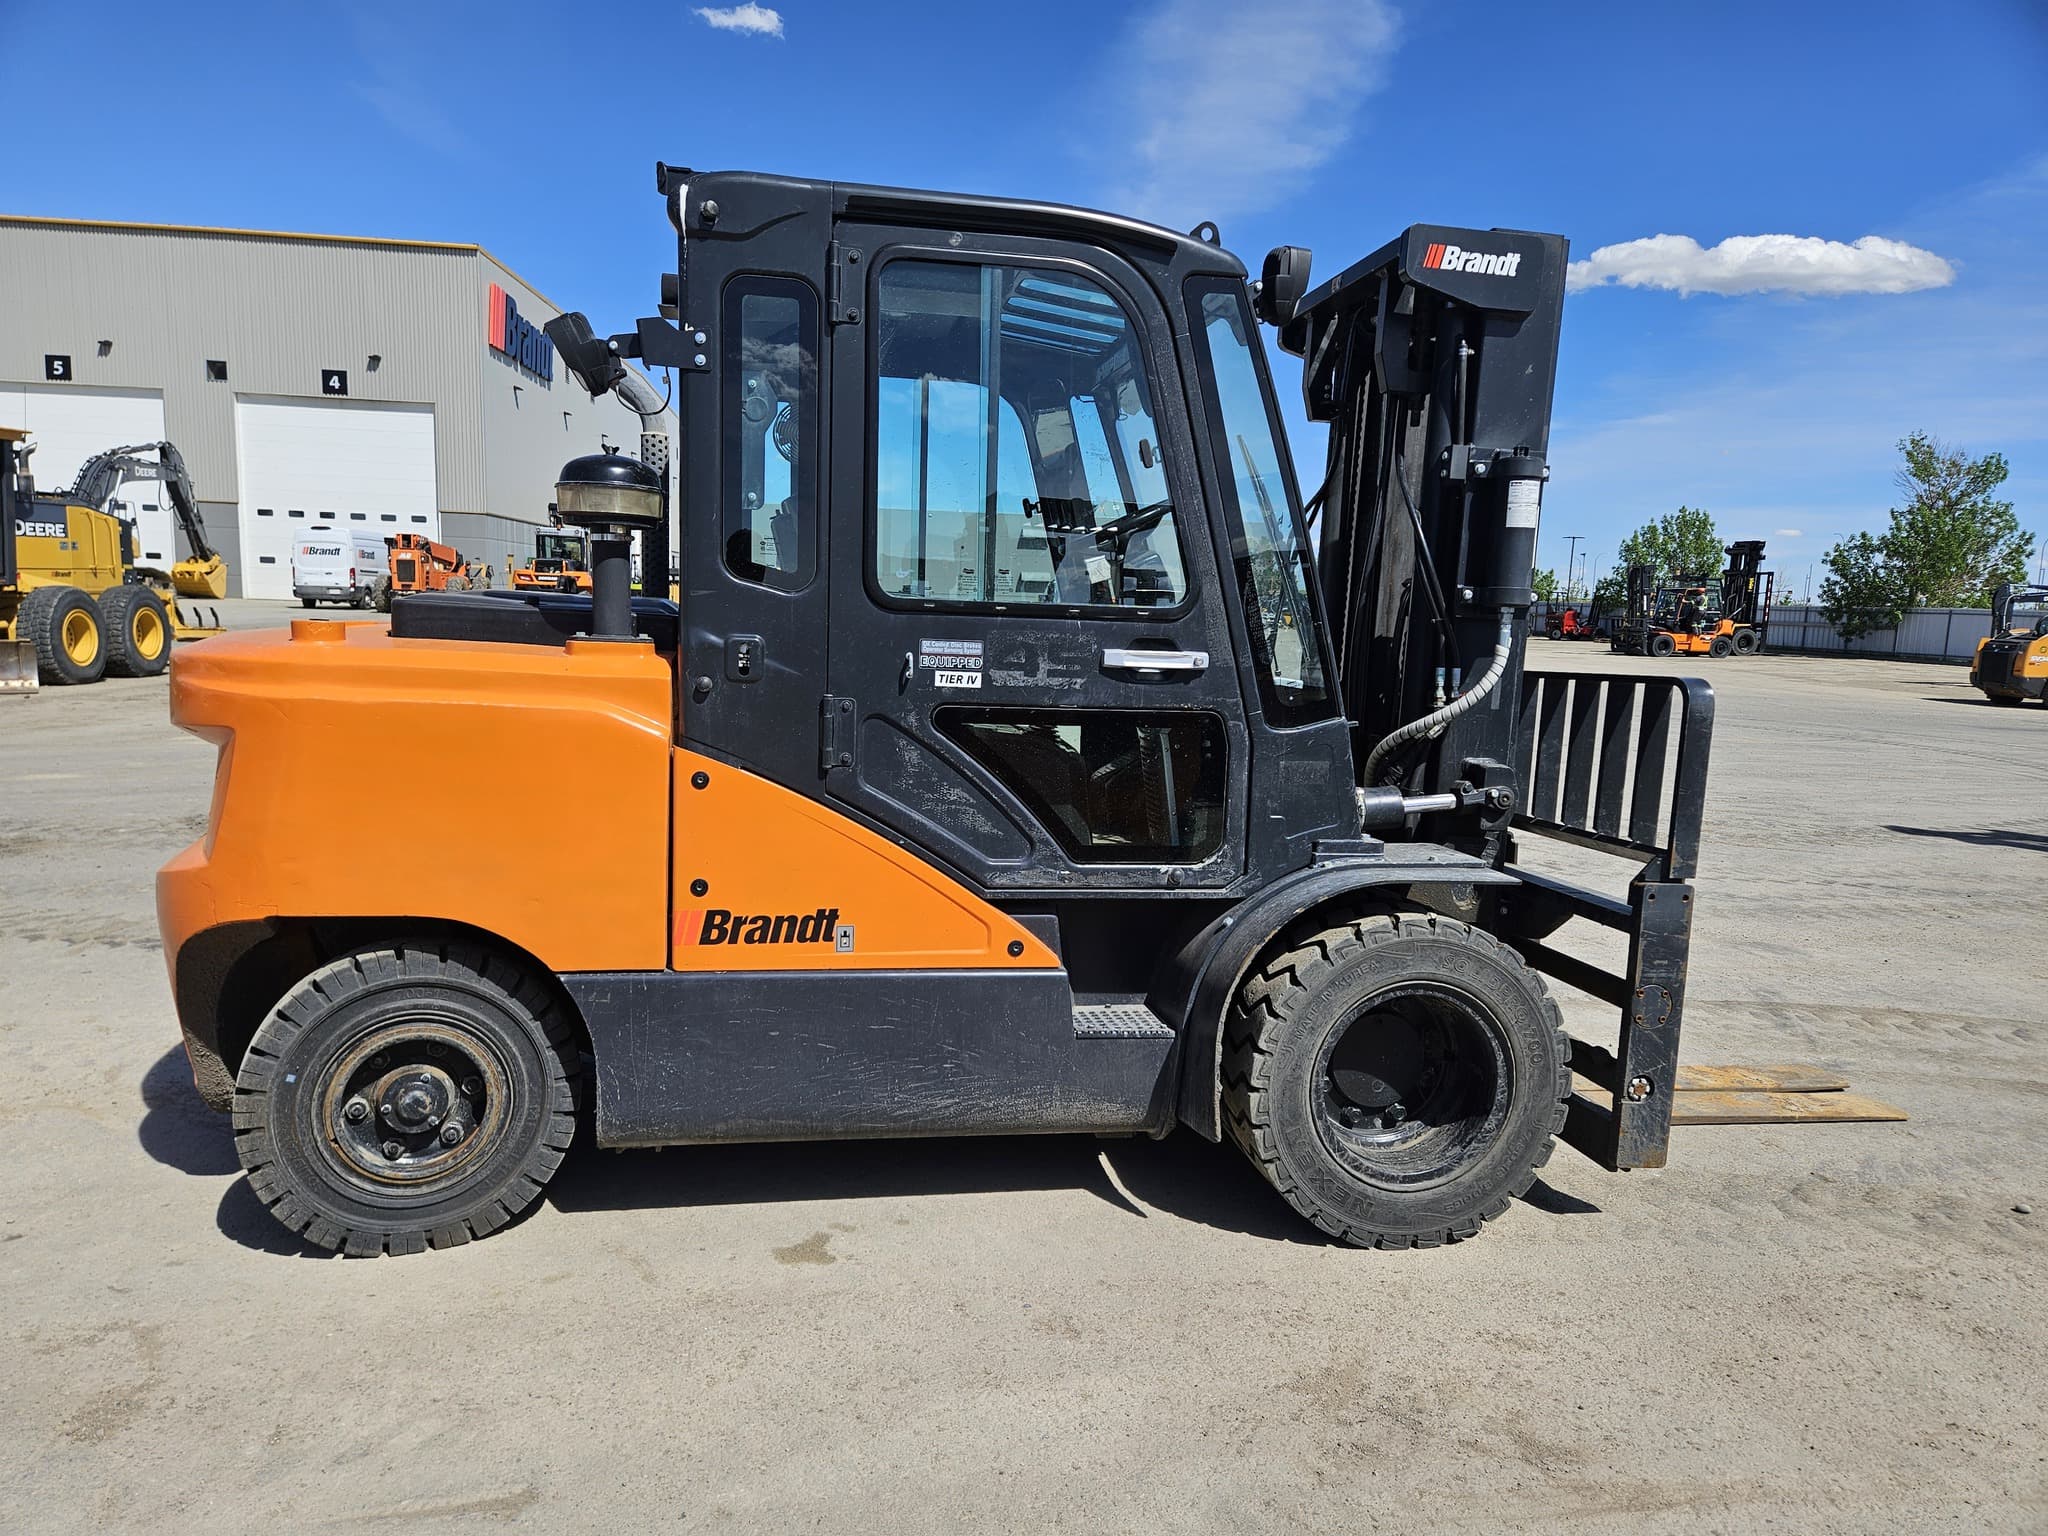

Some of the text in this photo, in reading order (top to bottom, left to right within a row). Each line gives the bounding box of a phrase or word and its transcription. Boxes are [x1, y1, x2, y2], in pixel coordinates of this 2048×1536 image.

[1440, 245, 1521, 277] Brandt
[53, 360, 64, 375] 5
[329, 375, 340, 389] 4
[135, 465, 158, 478] DEERE
[16, 519, 66, 538] DEERE
[309, 546, 341, 556] Brandt
[921, 655, 983, 669] EQUIPPED
[939, 674, 978, 685] TIER IV
[698, 908, 840, 946] Brandt
